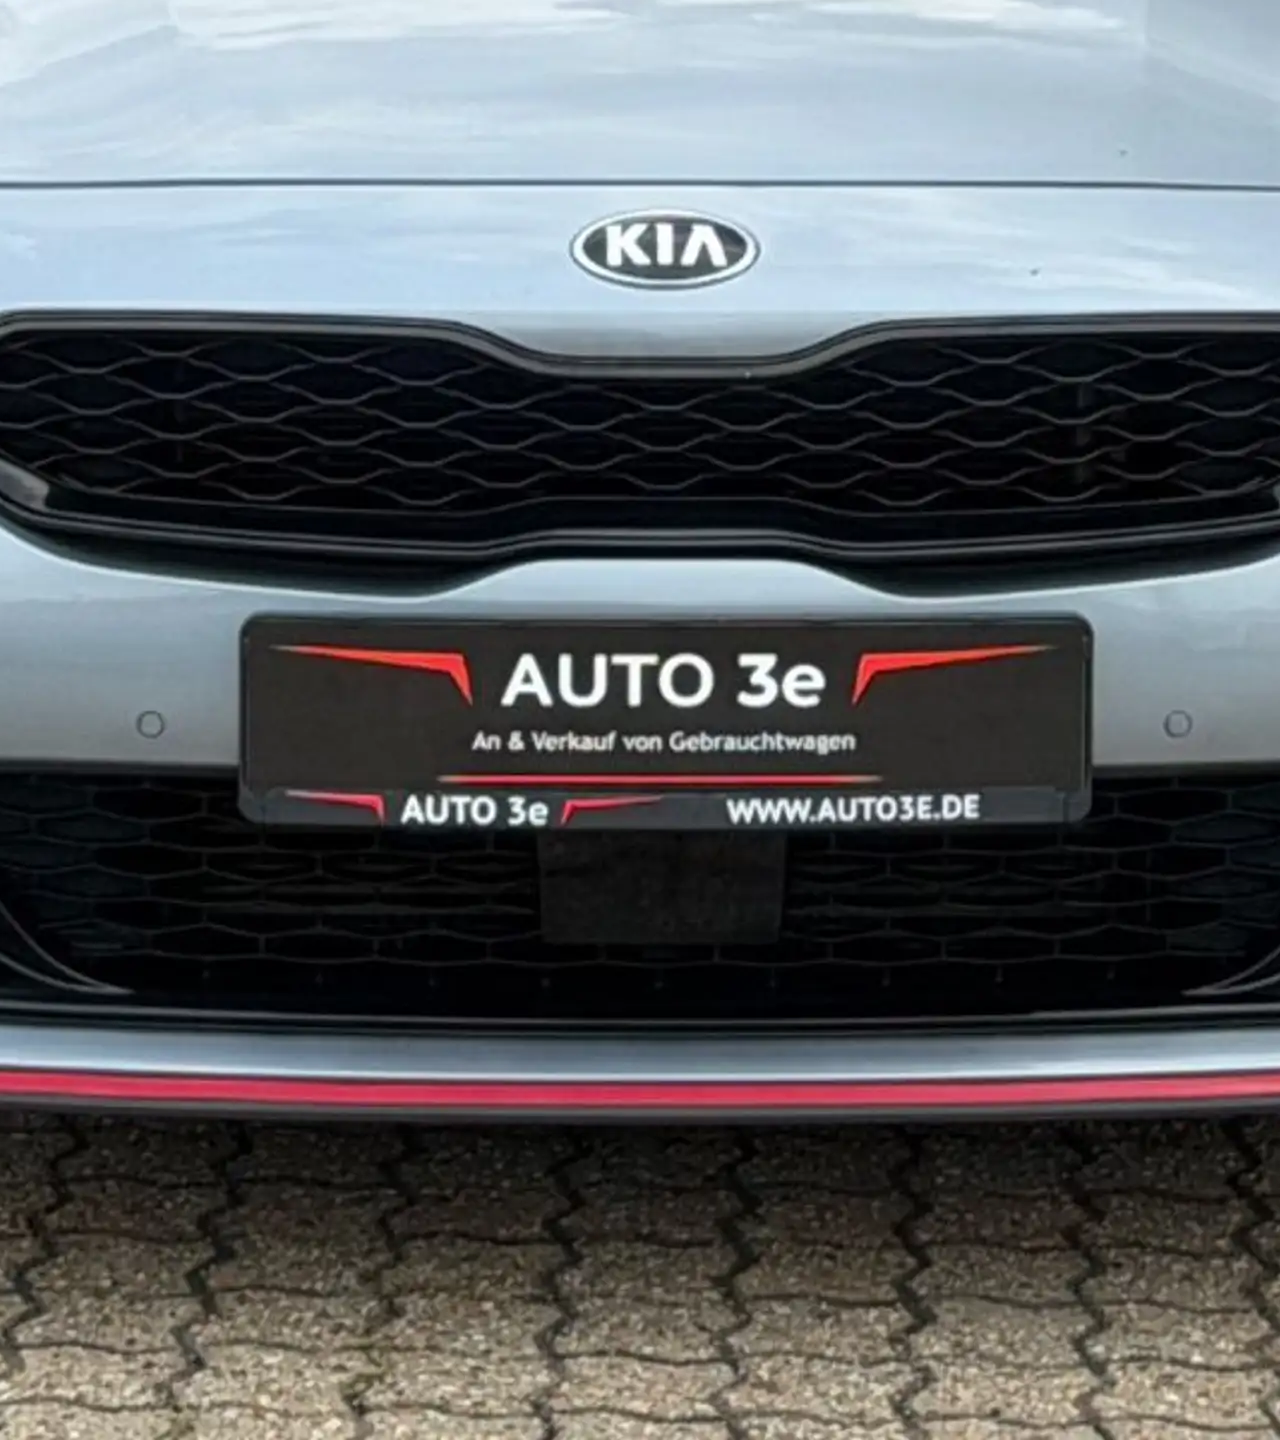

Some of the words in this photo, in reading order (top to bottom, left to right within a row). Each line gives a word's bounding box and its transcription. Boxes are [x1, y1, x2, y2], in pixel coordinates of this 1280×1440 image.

[605, 222, 729, 267] KIA
[500, 652, 714, 708] AUTO
[737, 653, 826, 708] 3e
[471, 730, 502, 751] An
[507, 730, 525, 751] &
[531, 730, 617, 752] Verkauf
[622, 735, 663, 752] von
[668, 730, 856, 756] Gebrauchtwagen
[400, 794, 497, 826] AUTO
[507, 795, 549, 826] 3e
[725, 793, 981, 825] WWW.AUTO3E.DE
